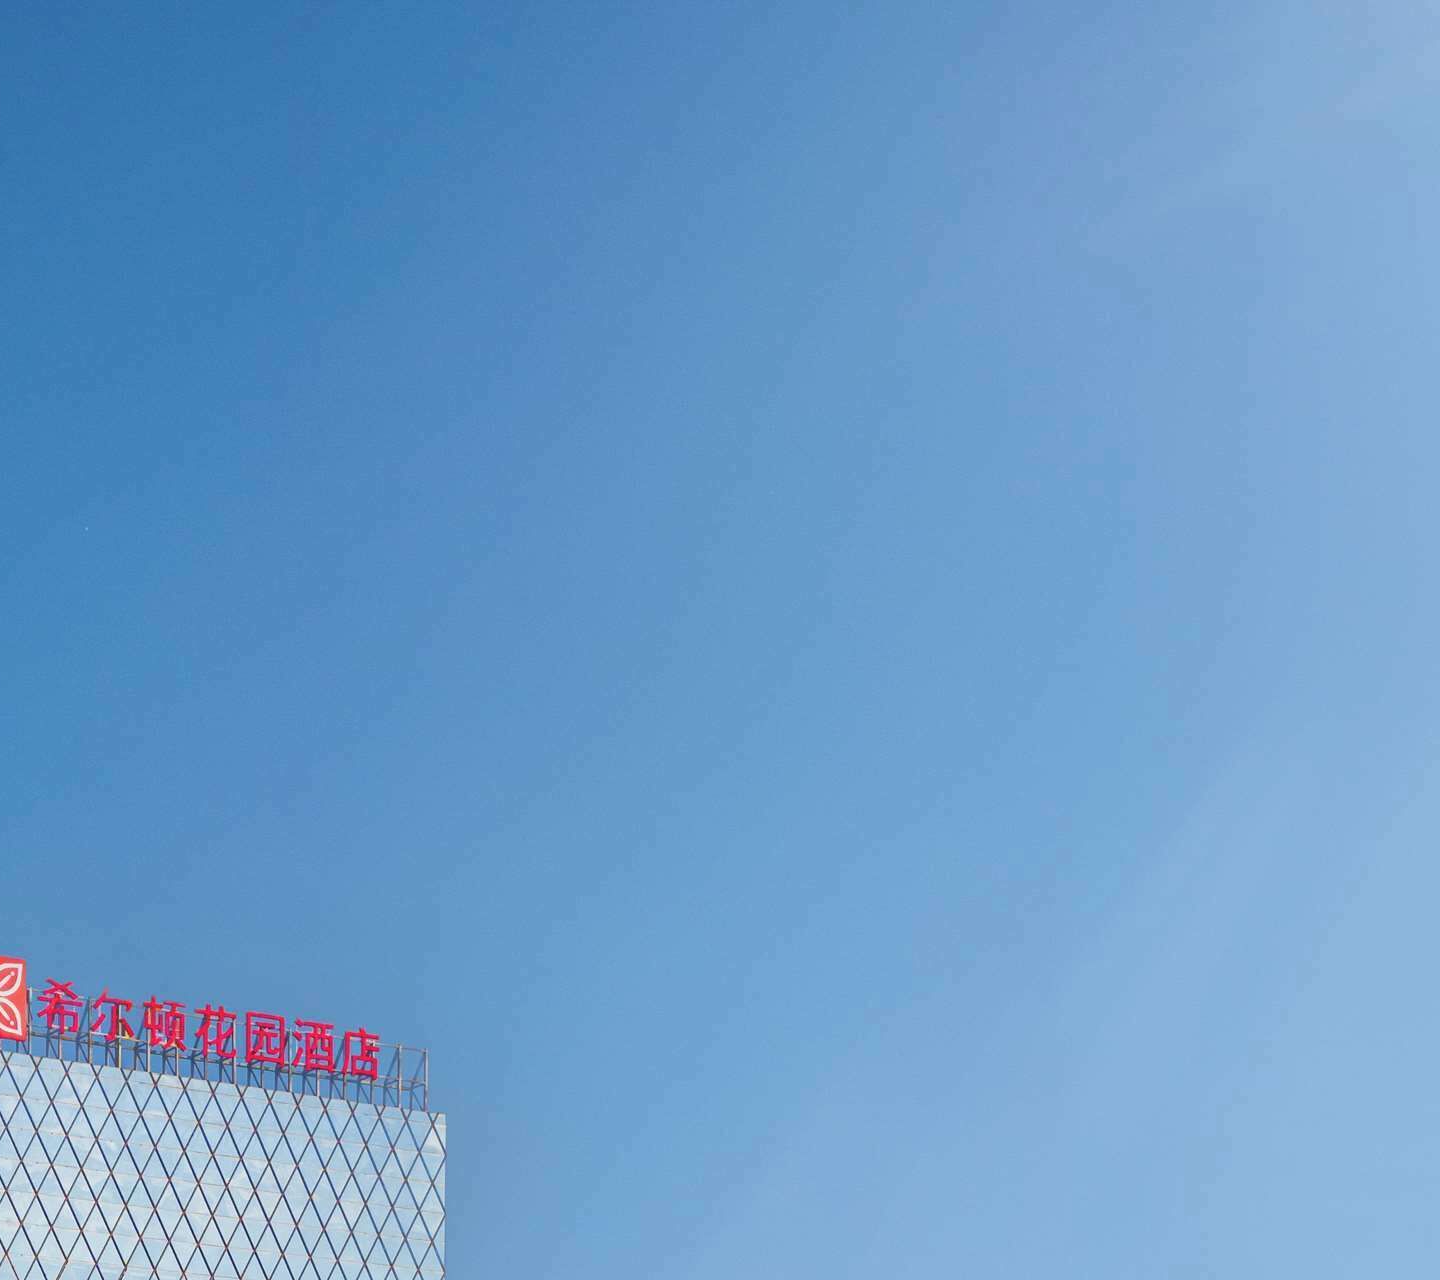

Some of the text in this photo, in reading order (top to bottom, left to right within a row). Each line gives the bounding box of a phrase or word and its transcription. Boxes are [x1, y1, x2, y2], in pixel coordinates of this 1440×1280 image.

[37, 977, 381, 1080] 希尔顿花园酒店
